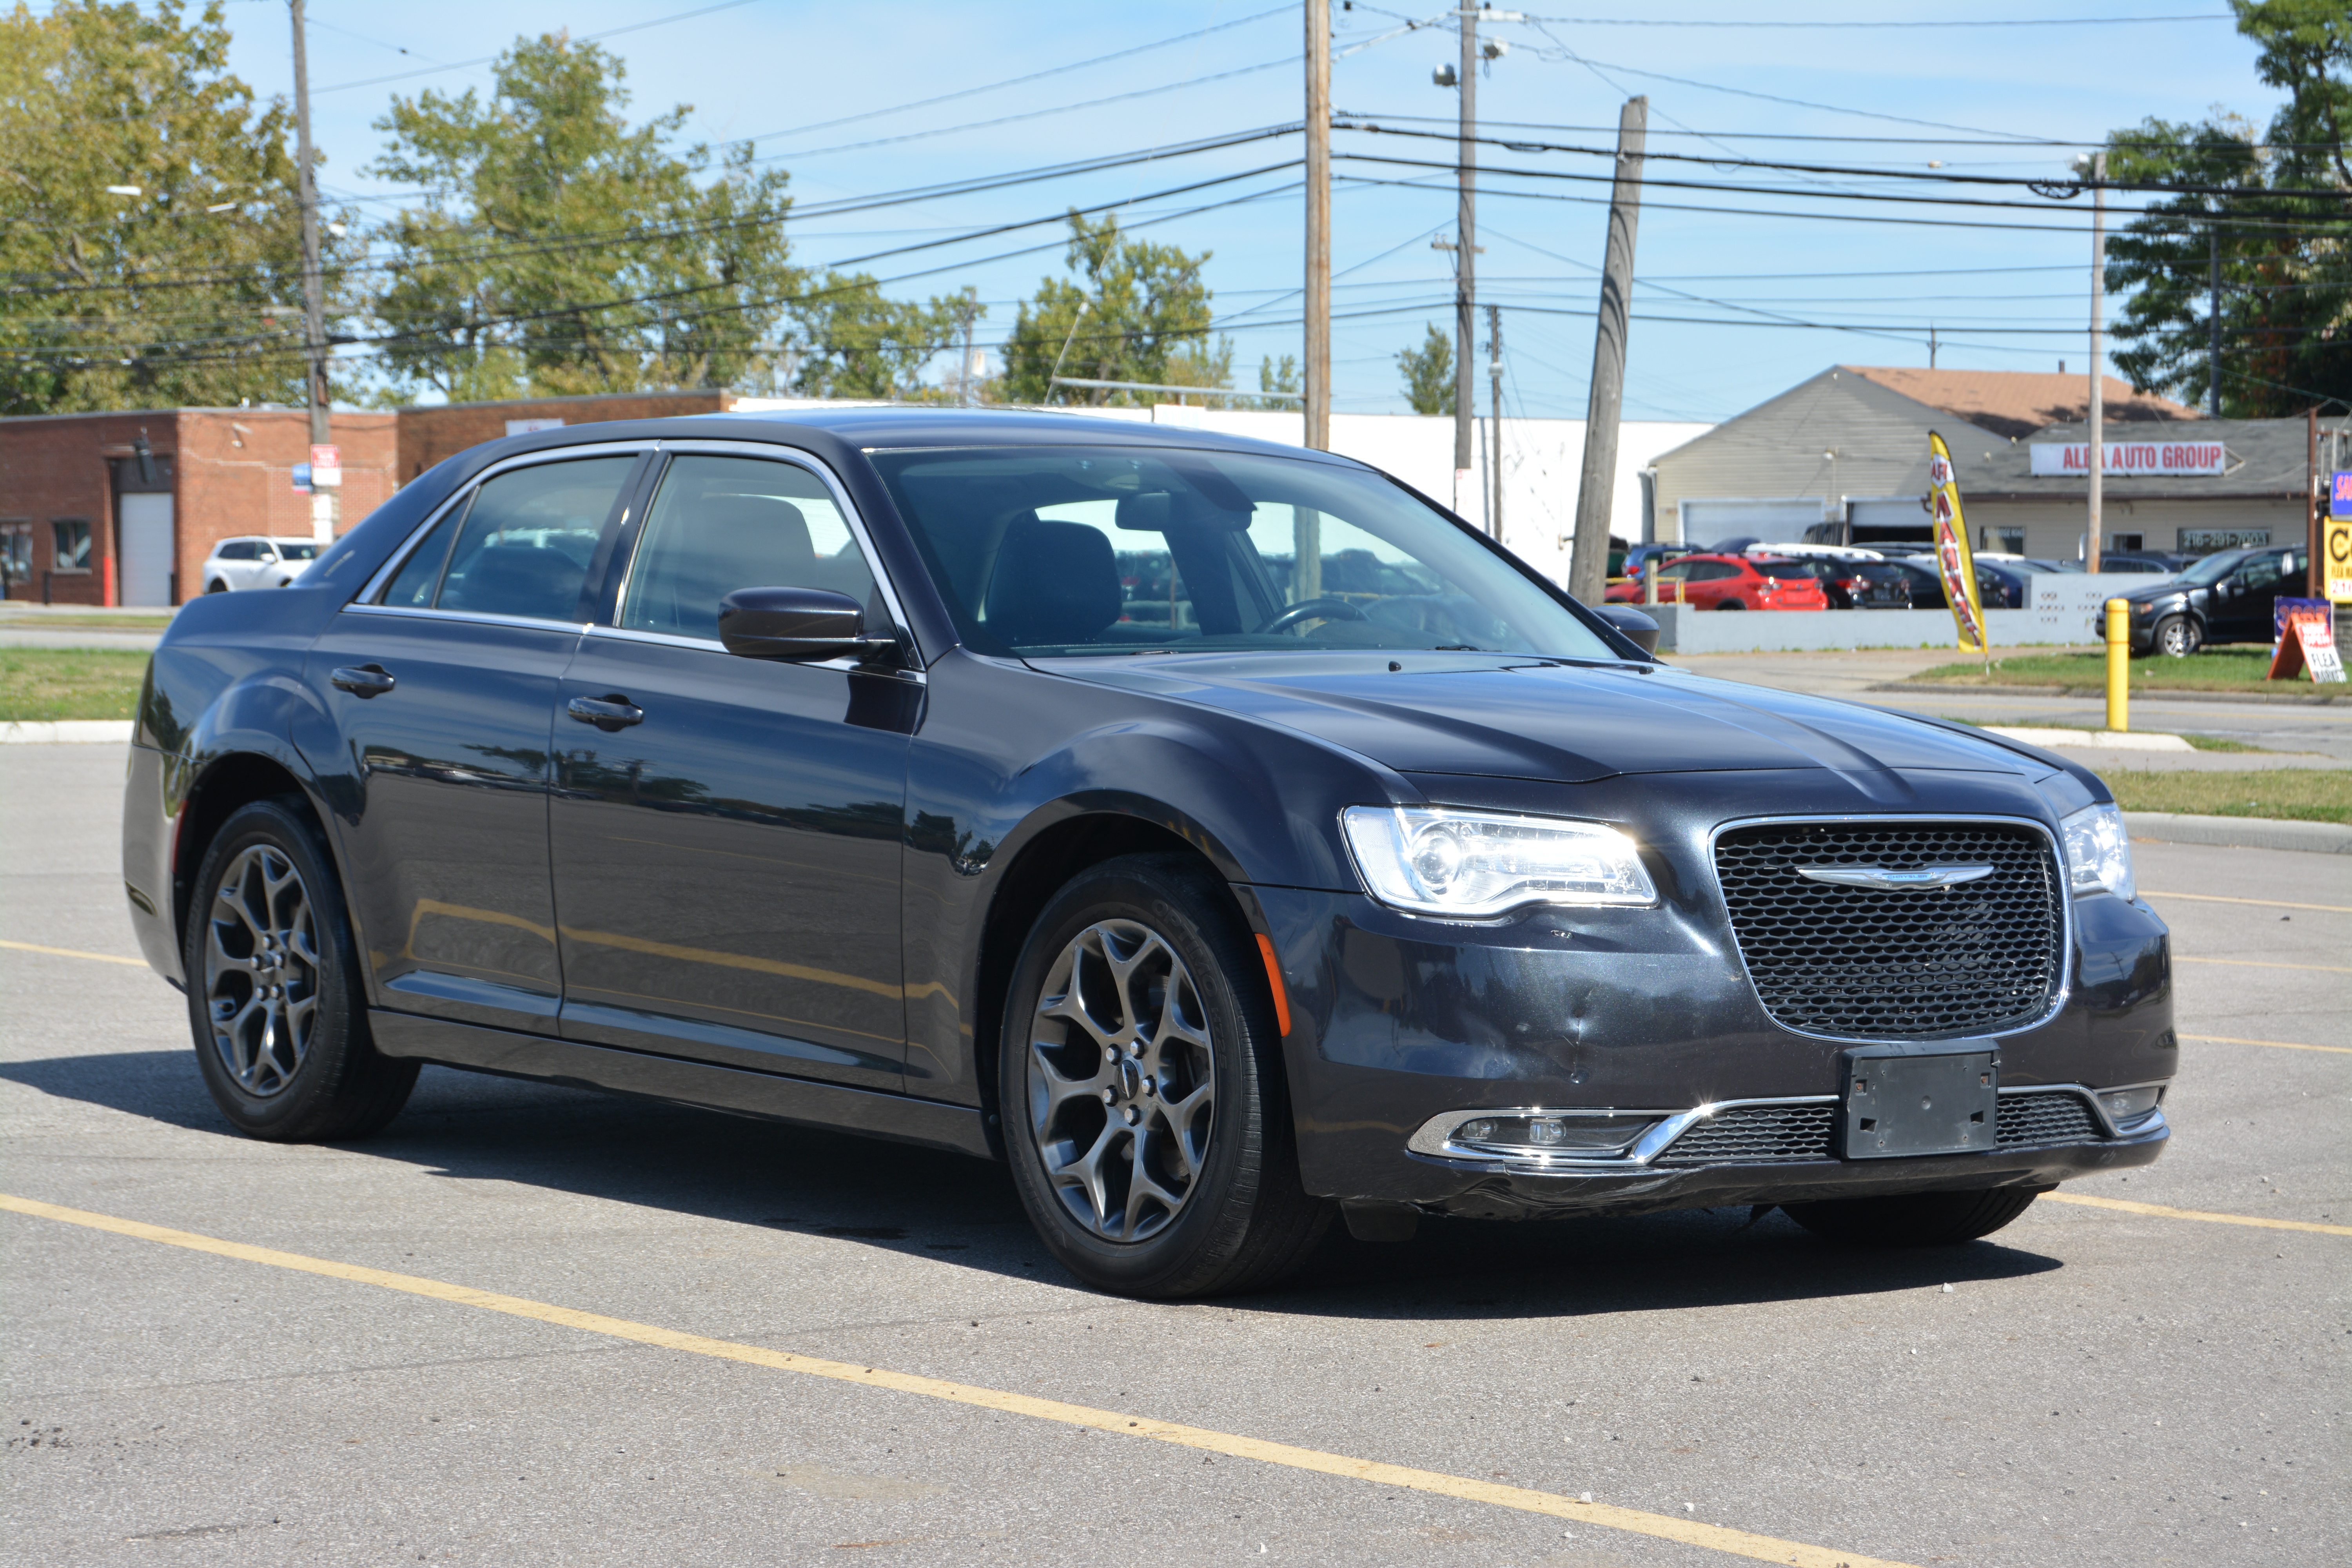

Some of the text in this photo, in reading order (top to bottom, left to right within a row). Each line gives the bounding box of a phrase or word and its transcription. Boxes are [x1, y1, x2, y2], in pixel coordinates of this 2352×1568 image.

[2112, 445, 2156, 468] AUTO
[2162, 445, 2221, 468] GROUP
[2311, 653, 2336, 667] FLEA
[1151, 898, 1227, 1070] OPTIMO H725
